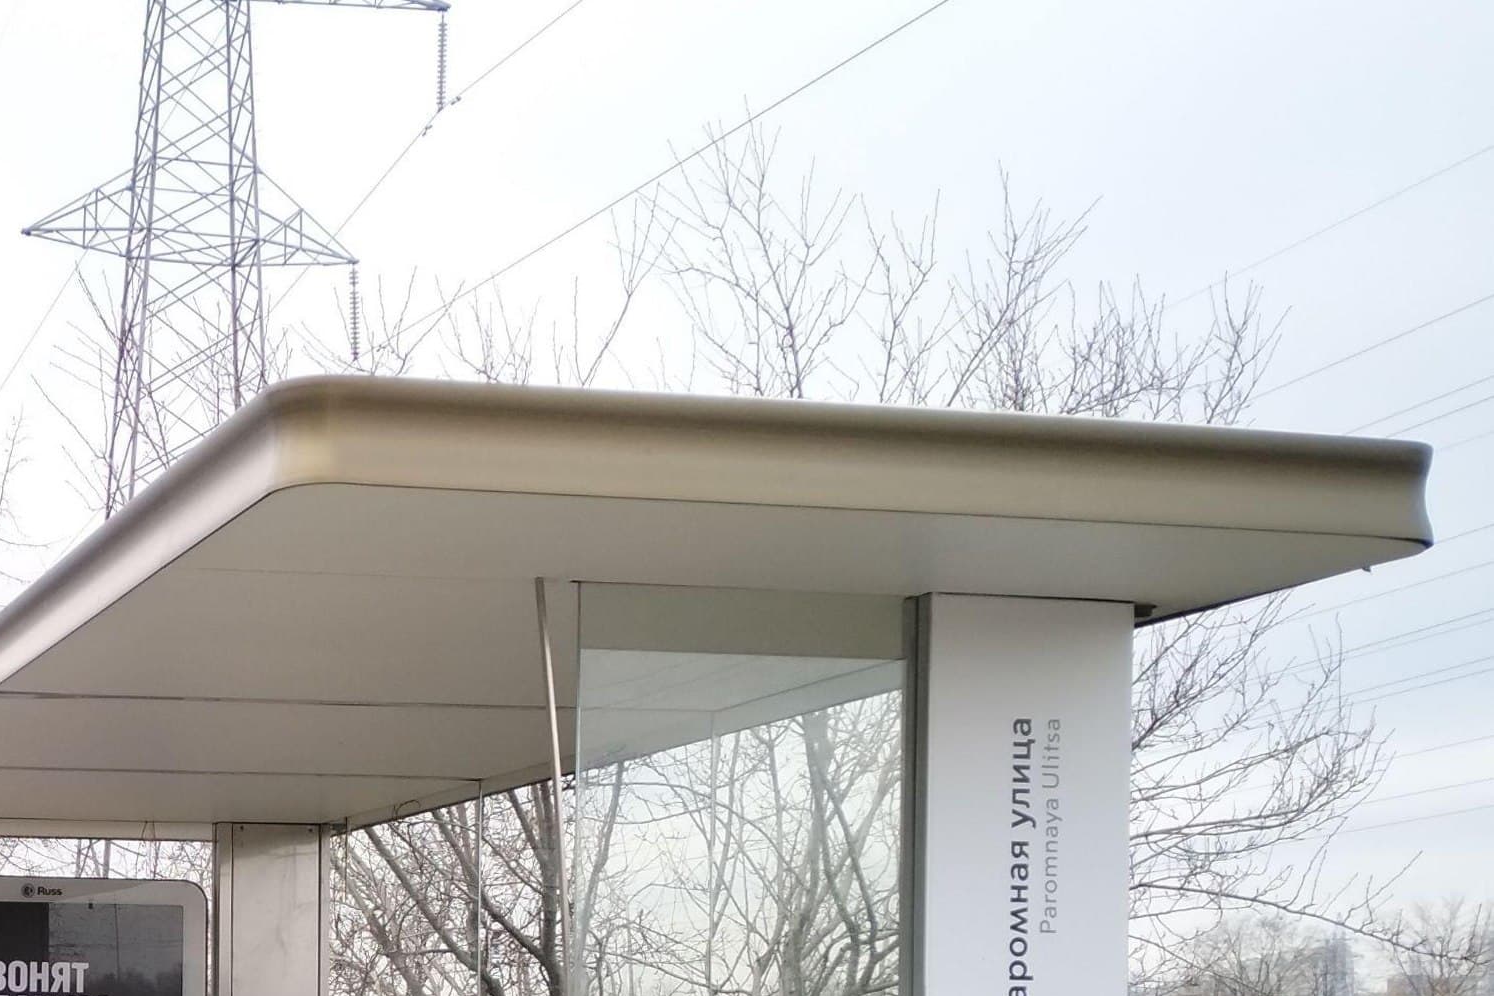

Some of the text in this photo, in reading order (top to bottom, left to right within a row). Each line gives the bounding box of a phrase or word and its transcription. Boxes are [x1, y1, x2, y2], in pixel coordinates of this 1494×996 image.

[1011, 717, 1037, 829] улица
[1039, 718, 1063, 934] Paromnaya Ulitsa
[37, 886, 62, 896] Russ
